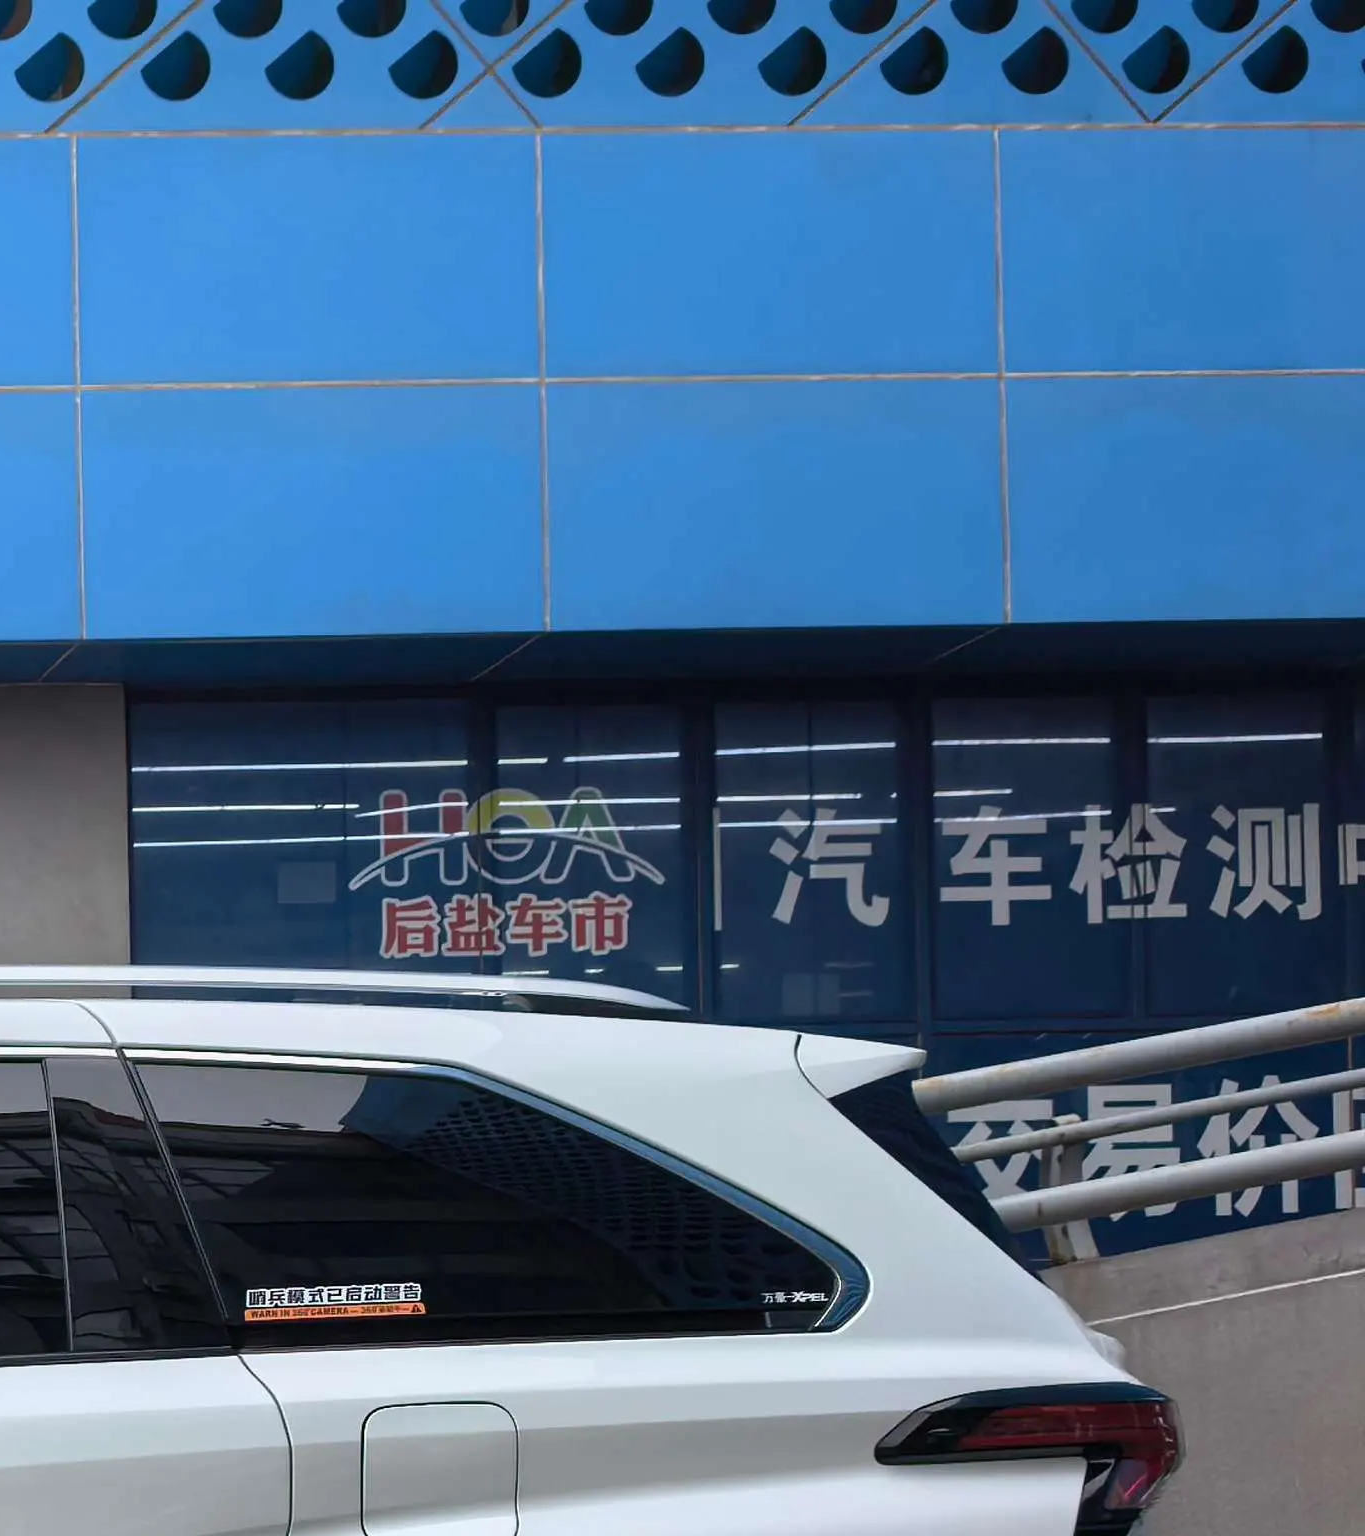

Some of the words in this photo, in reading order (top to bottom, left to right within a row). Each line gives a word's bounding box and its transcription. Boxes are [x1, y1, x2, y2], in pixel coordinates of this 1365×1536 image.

[769, 803, 1365, 927] 汽车检测
[380, 890, 633, 958] 后盐车市
[948, 1075, 1365, 1222] 交易价
[247, 1284, 421, 1307] 哨兵模式已启动警告
